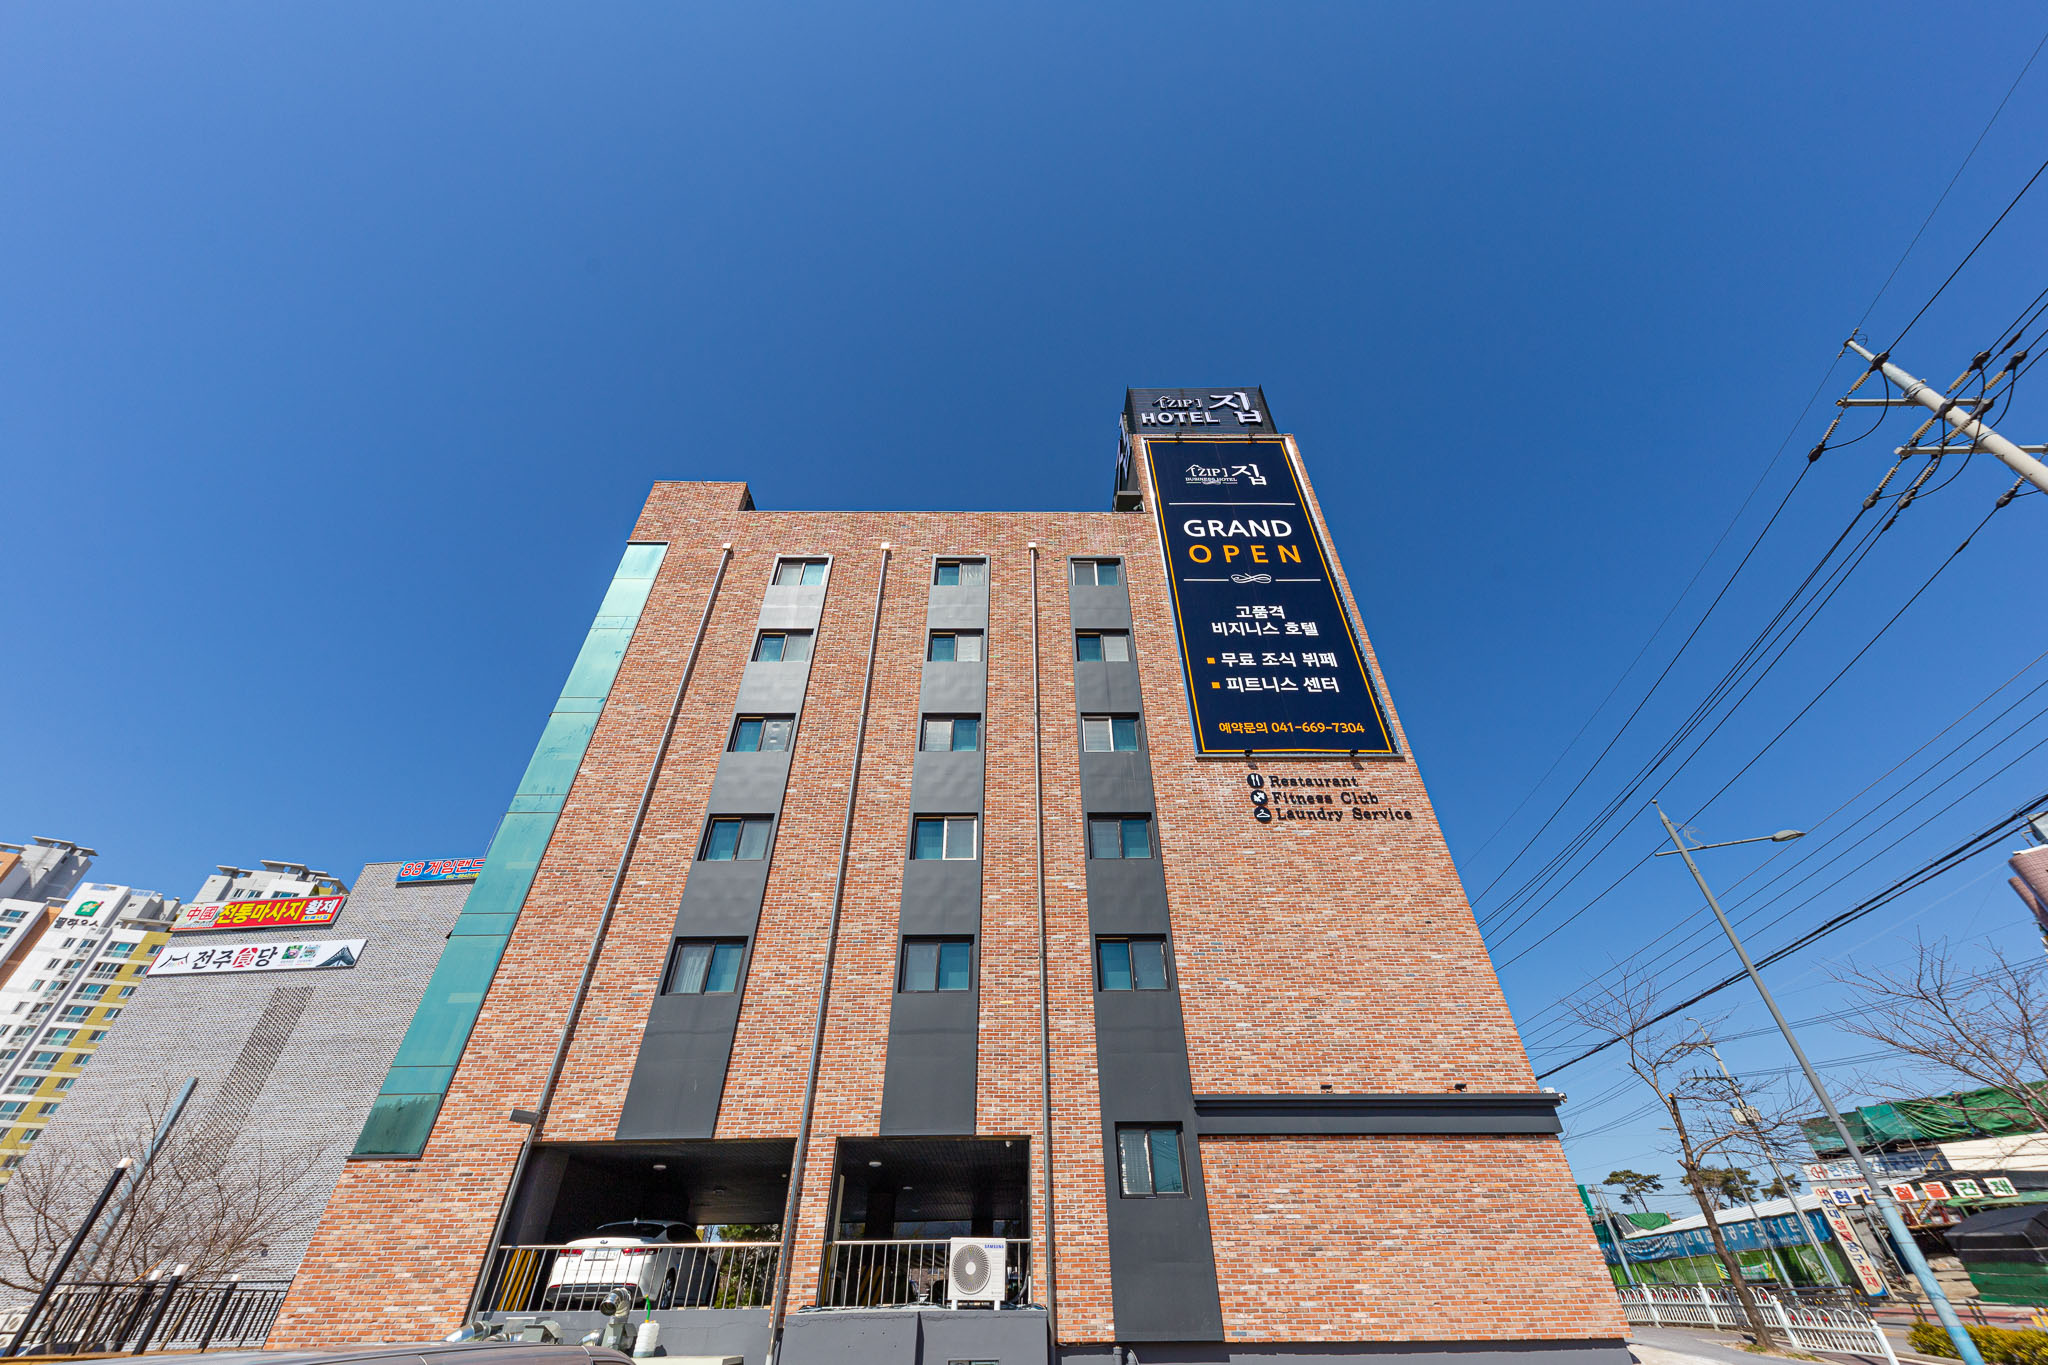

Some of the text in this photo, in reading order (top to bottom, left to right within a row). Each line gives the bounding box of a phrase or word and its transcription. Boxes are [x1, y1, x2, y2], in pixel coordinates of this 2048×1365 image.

[1207, 391, 1263, 424] 집
[1141, 411, 1220, 424] HOTEL
[1231, 463, 1267, 486] 집
[1183, 519, 1292, 537] GRAND
[1188, 544, 1302, 563] OPEN
[1235, 605, 1286, 620] 고품격
[1211, 621, 1319, 636] 비지니스 호텔
[1221, 652, 1339, 667] 무료 조식 뷔페
[1225, 677, 1340, 693] 피트니스 센터
[1218, 722, 1365, 734] 예약문의 041-669-7304
[1268, 775, 1359, 788] Restaurant
[1271, 791, 1379, 804] Fitness Club
[1275, 807, 1413, 822] Laundry Service
[401, 859, 486, 877] 88 게임랜드
[186, 904, 219, 921] 中國
[216, 900, 307, 924] 전통마사지
[305, 899, 340, 915] 황제
